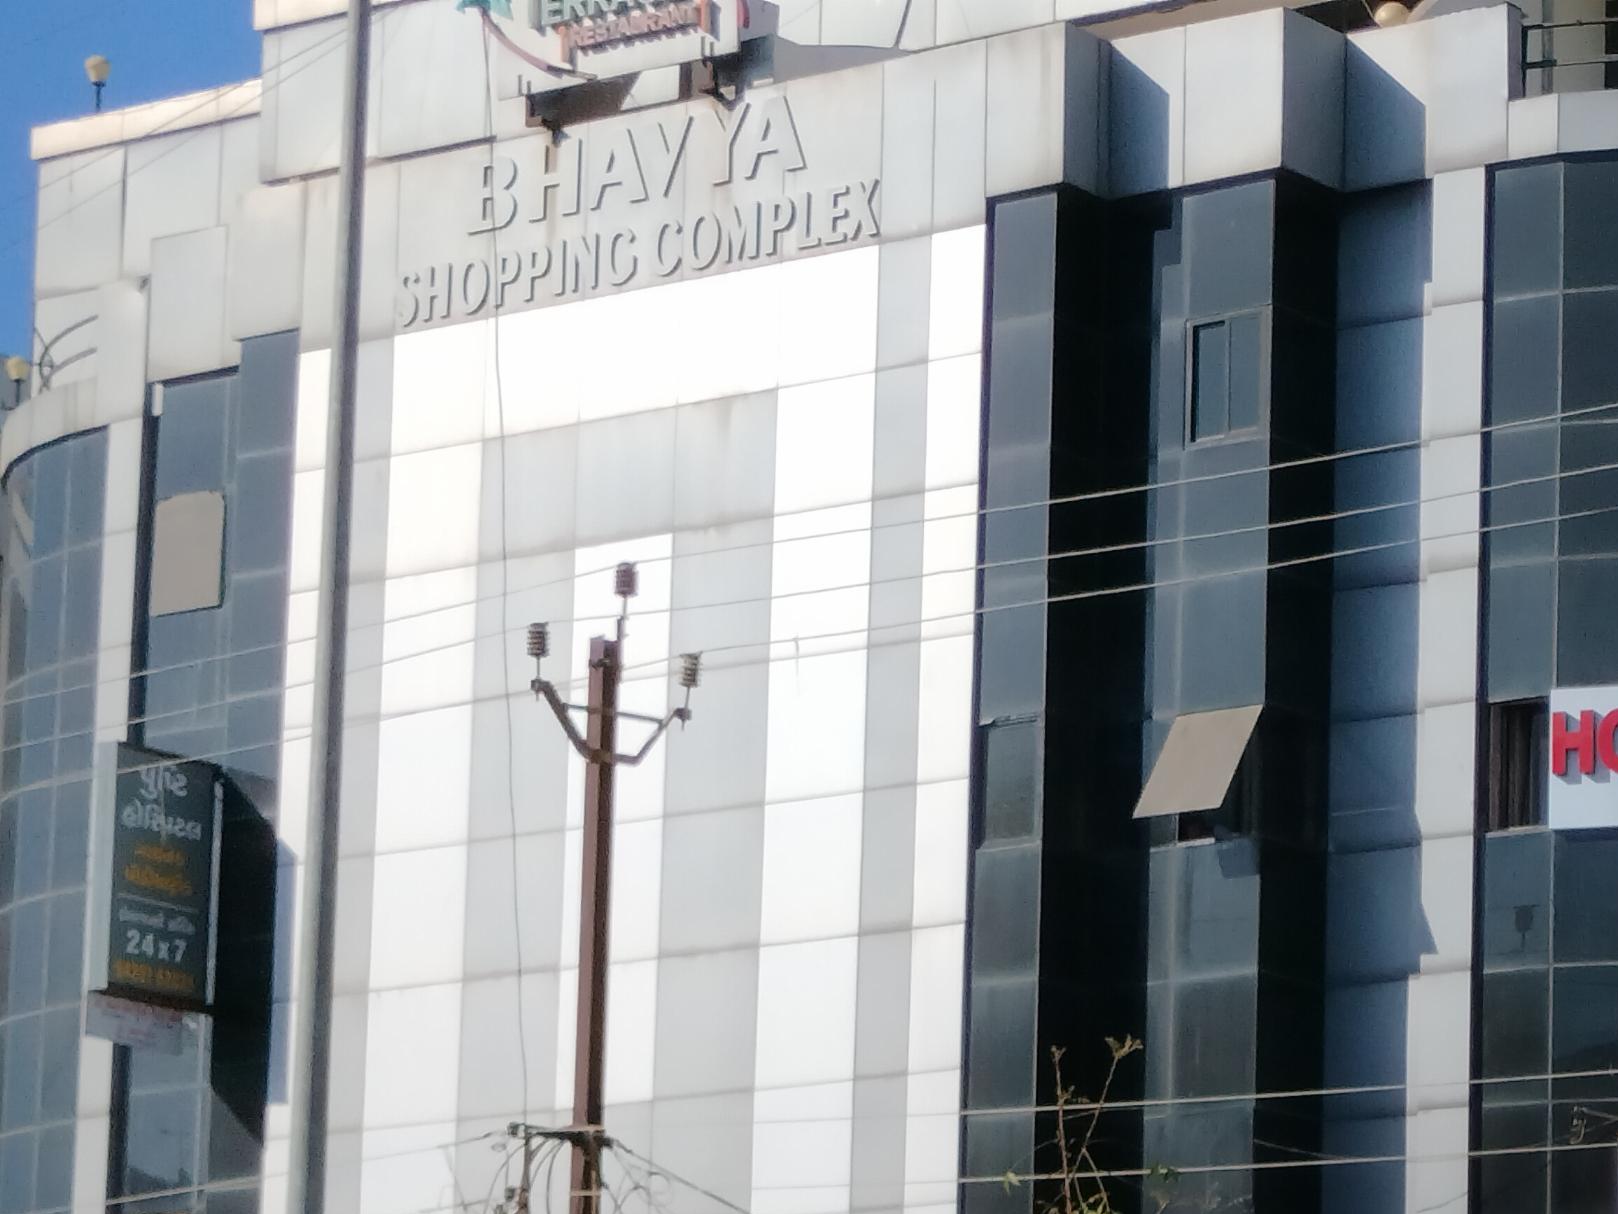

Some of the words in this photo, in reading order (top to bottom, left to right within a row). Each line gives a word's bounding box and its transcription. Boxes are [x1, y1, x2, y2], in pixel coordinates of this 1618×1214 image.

[467, 96, 807, 235] BHAVYA
[400, 226, 638, 327] SHOPPING
[657, 179, 880, 276] COMPLEX
